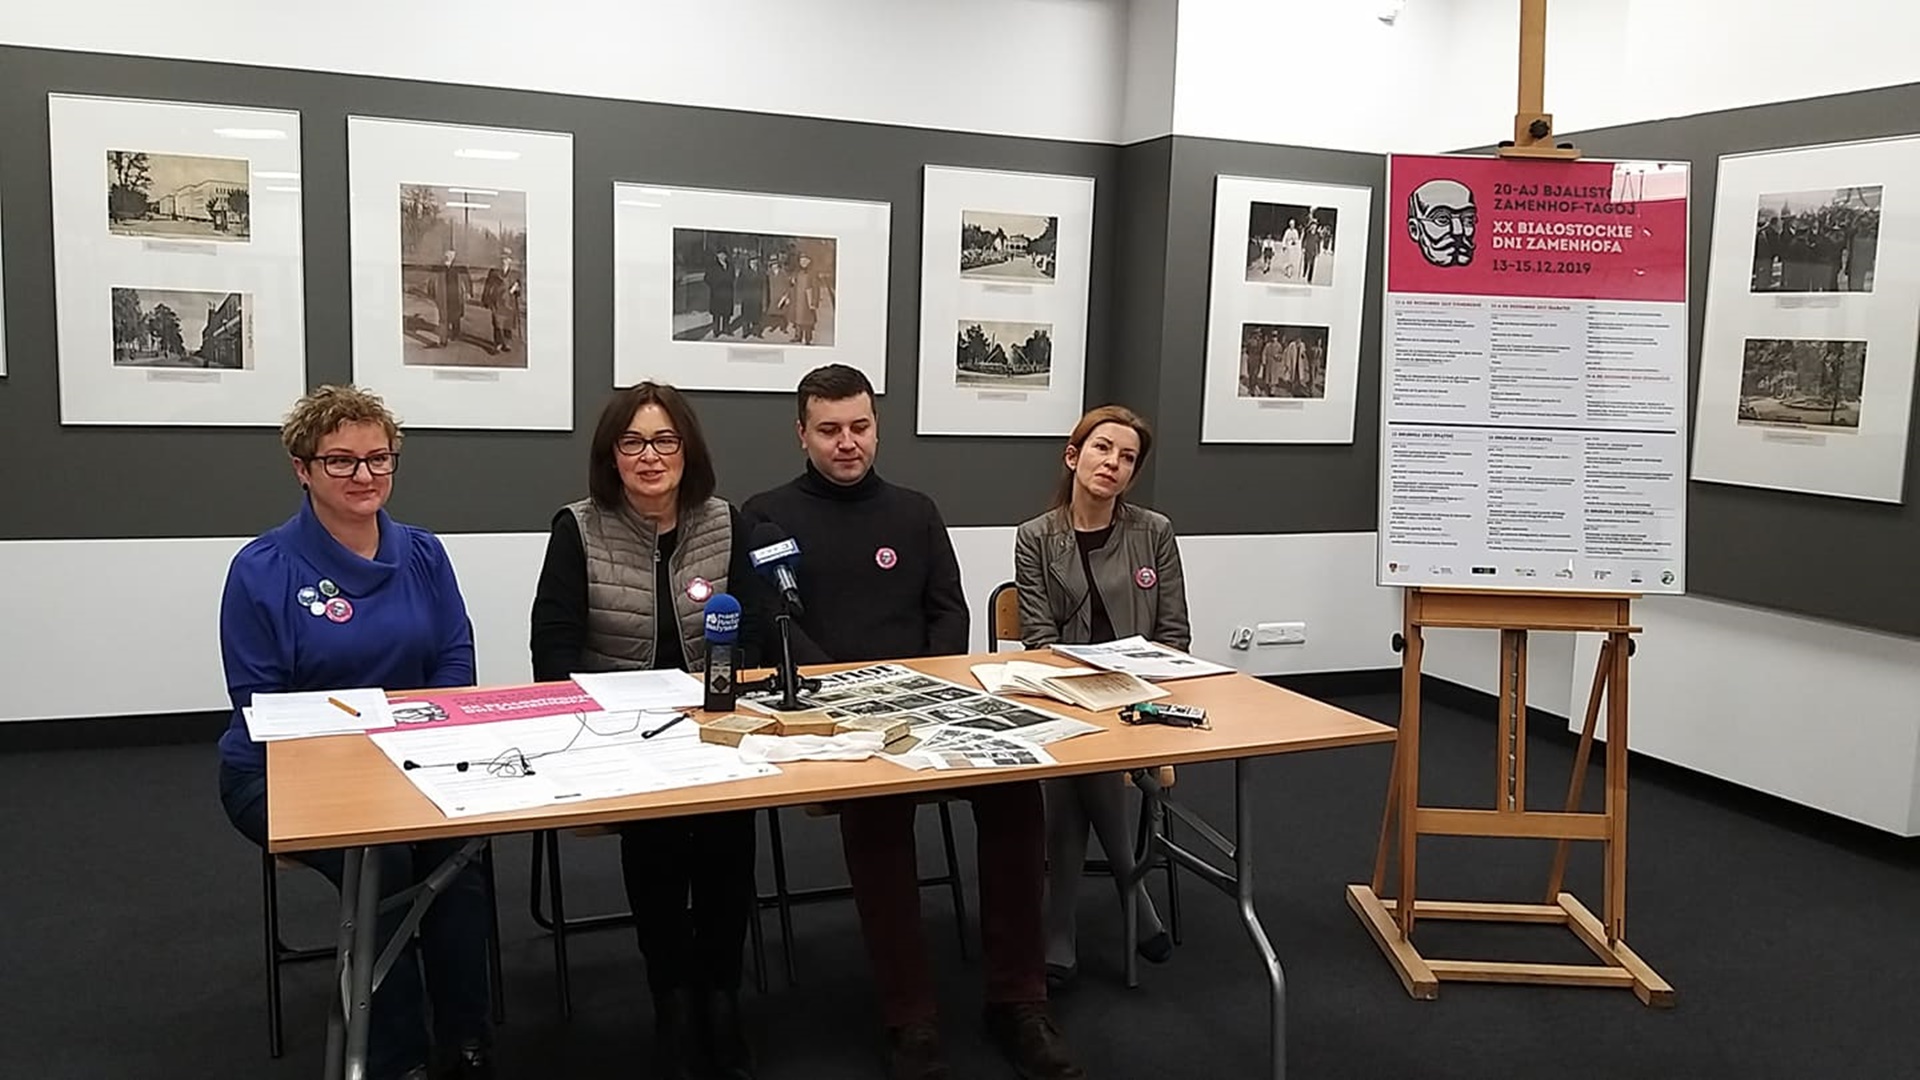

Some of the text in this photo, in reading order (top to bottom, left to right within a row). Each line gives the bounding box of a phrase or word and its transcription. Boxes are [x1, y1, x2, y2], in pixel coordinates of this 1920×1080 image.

[1494, 183, 1538, 196] 20-AJ
[1494, 198, 1636, 215] ZAMENHOF-TAGOJ
[1493, 221, 1633, 238] XX BIAŁOSTOCKIE
[1492, 236, 1623, 253] DNI ZAMENHOFA
[1492, 259, 1591, 274] 13-15.12.2019
